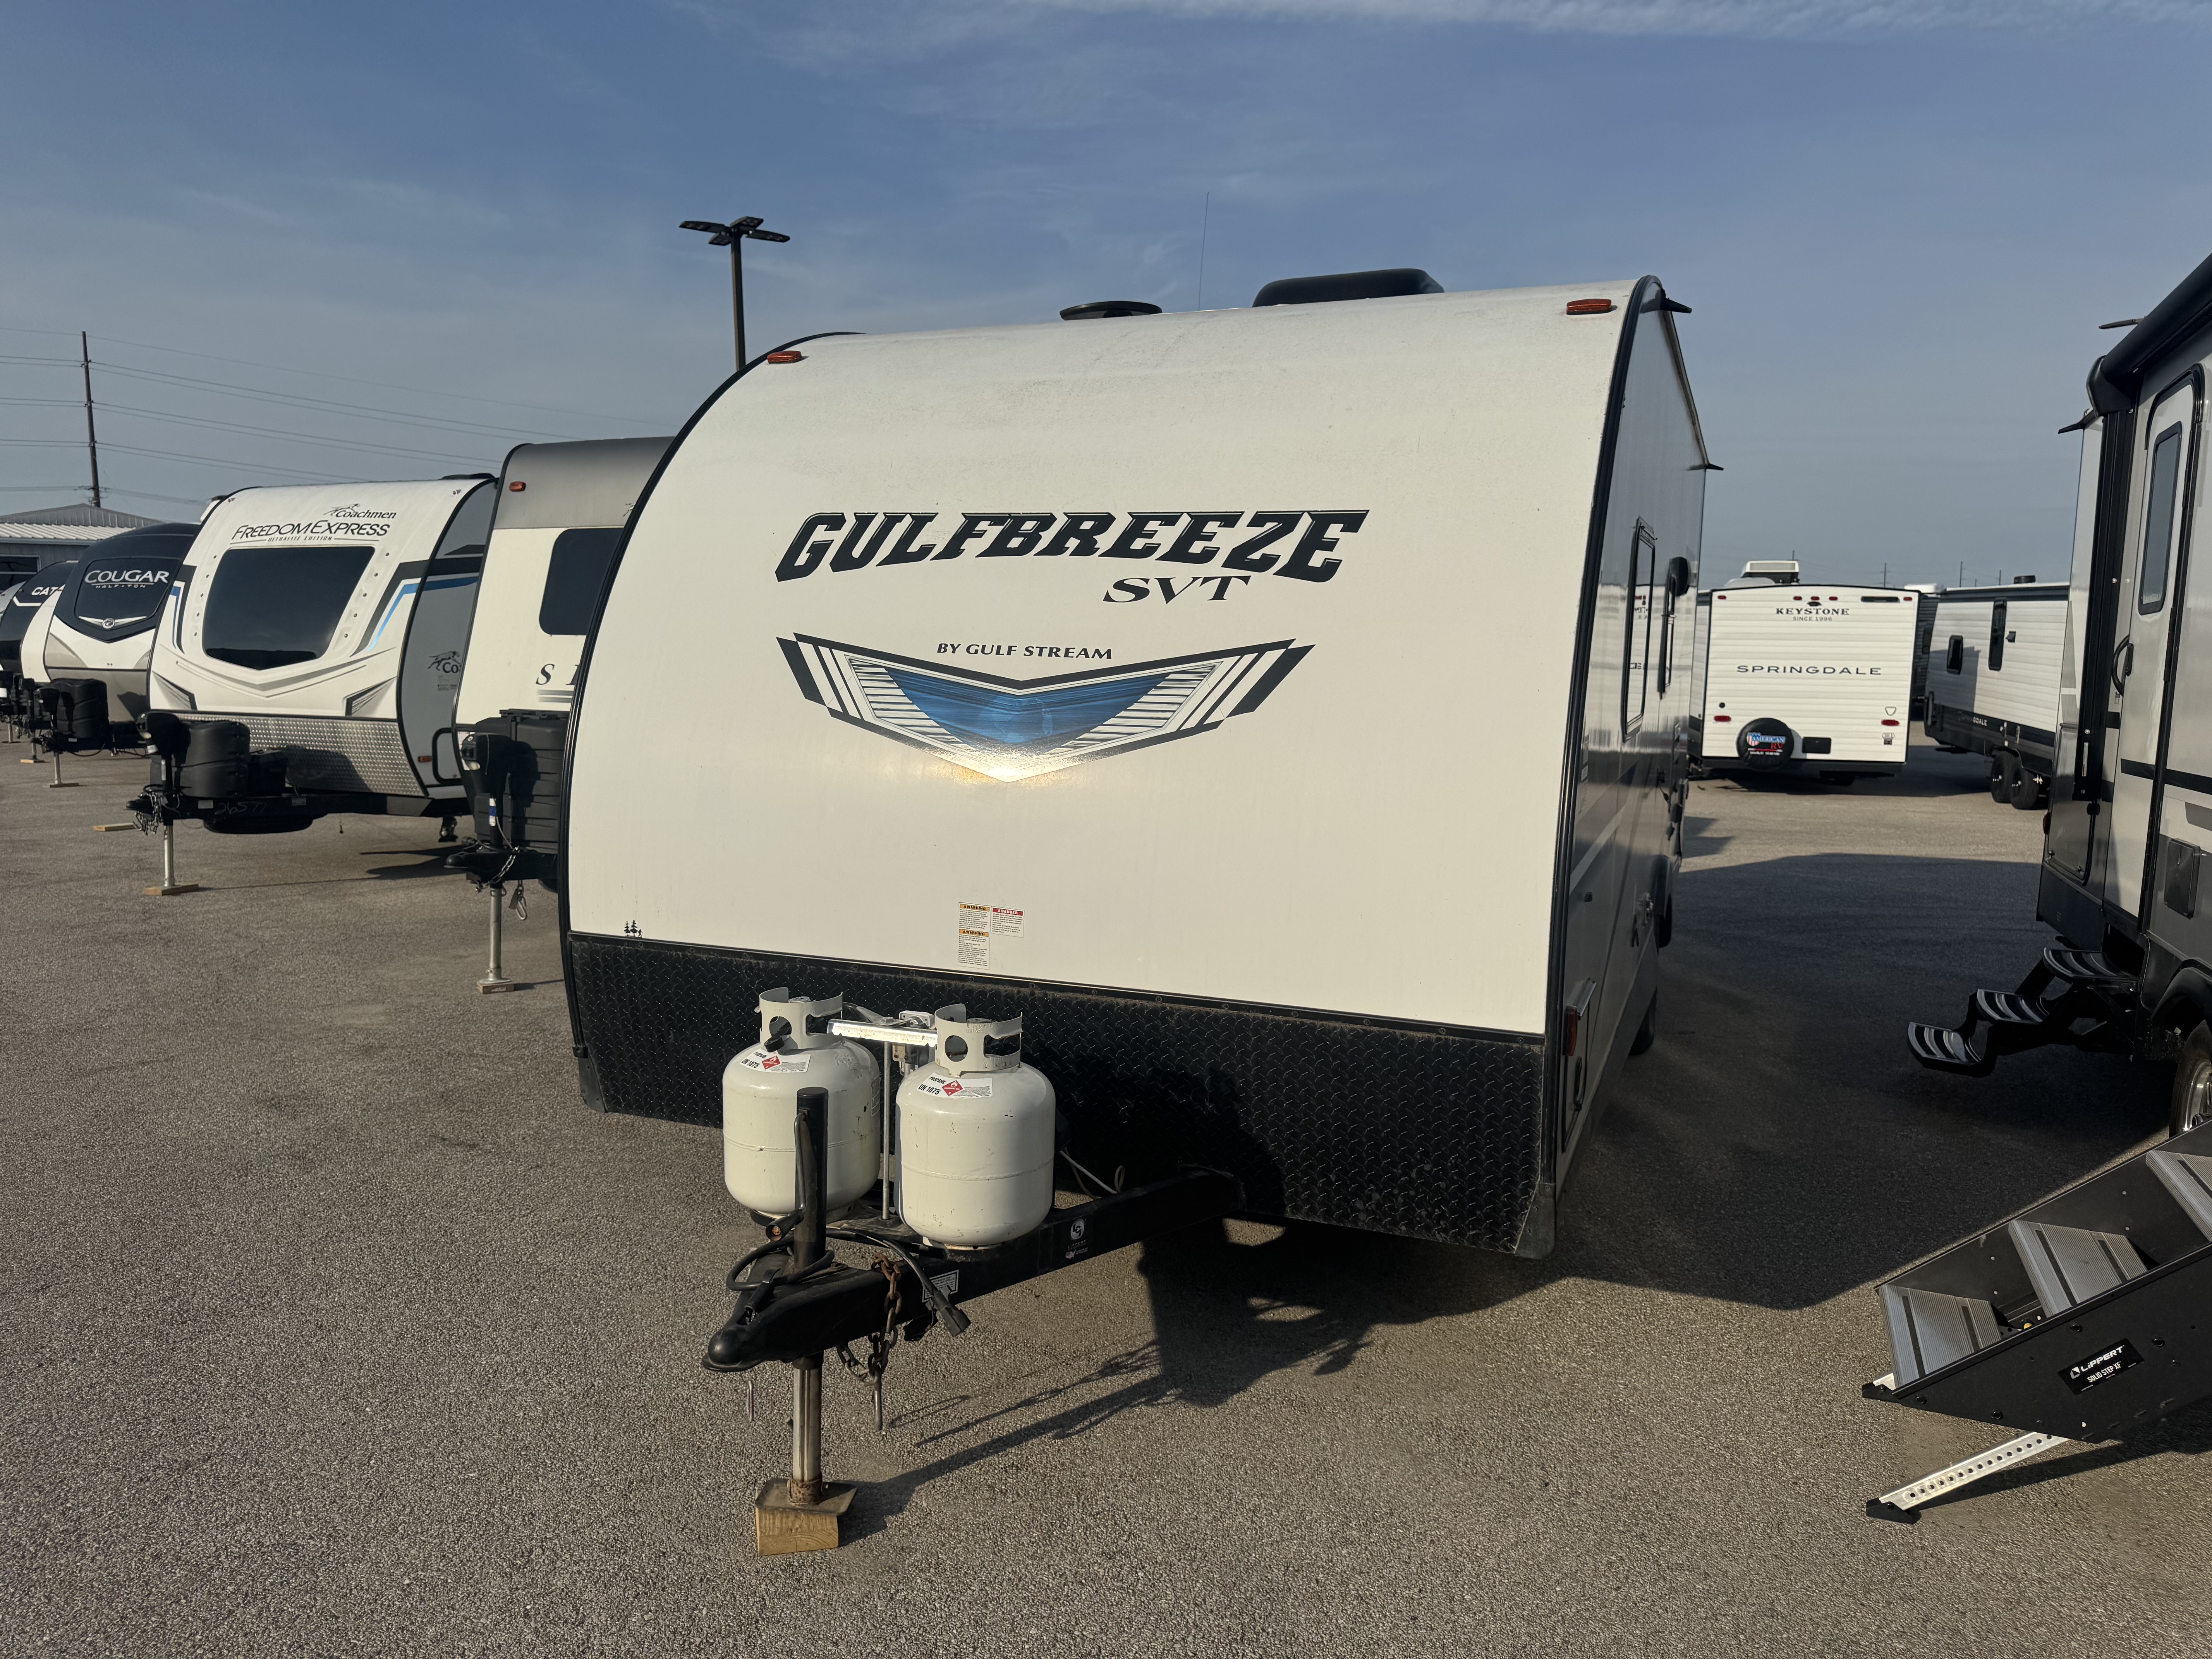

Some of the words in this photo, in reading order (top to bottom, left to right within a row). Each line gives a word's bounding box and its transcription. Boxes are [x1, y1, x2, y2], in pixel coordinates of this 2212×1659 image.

[336, 510, 397, 519] Coachmen
[231, 522, 313, 540] FREEDOM
[311, 520, 390, 536] EXPRESS
[775, 510, 1370, 582] GULFBREEZE
[85, 570, 169, 584] COUGAR
[1103, 575, 1251, 605] SVT
[937, 643, 961, 654] BY
[966, 644, 1017, 656] GULF
[1023, 646, 1112, 659] STREAM
[1736, 665, 1881, 675] SPRINGDALE
[926, 1087, 941, 1095] 1075
[2087, 1372, 2103, 1383] SOLID
[2101, 1365, 2114, 1376] STEP
[2112, 1361, 2121, 1370] XF
